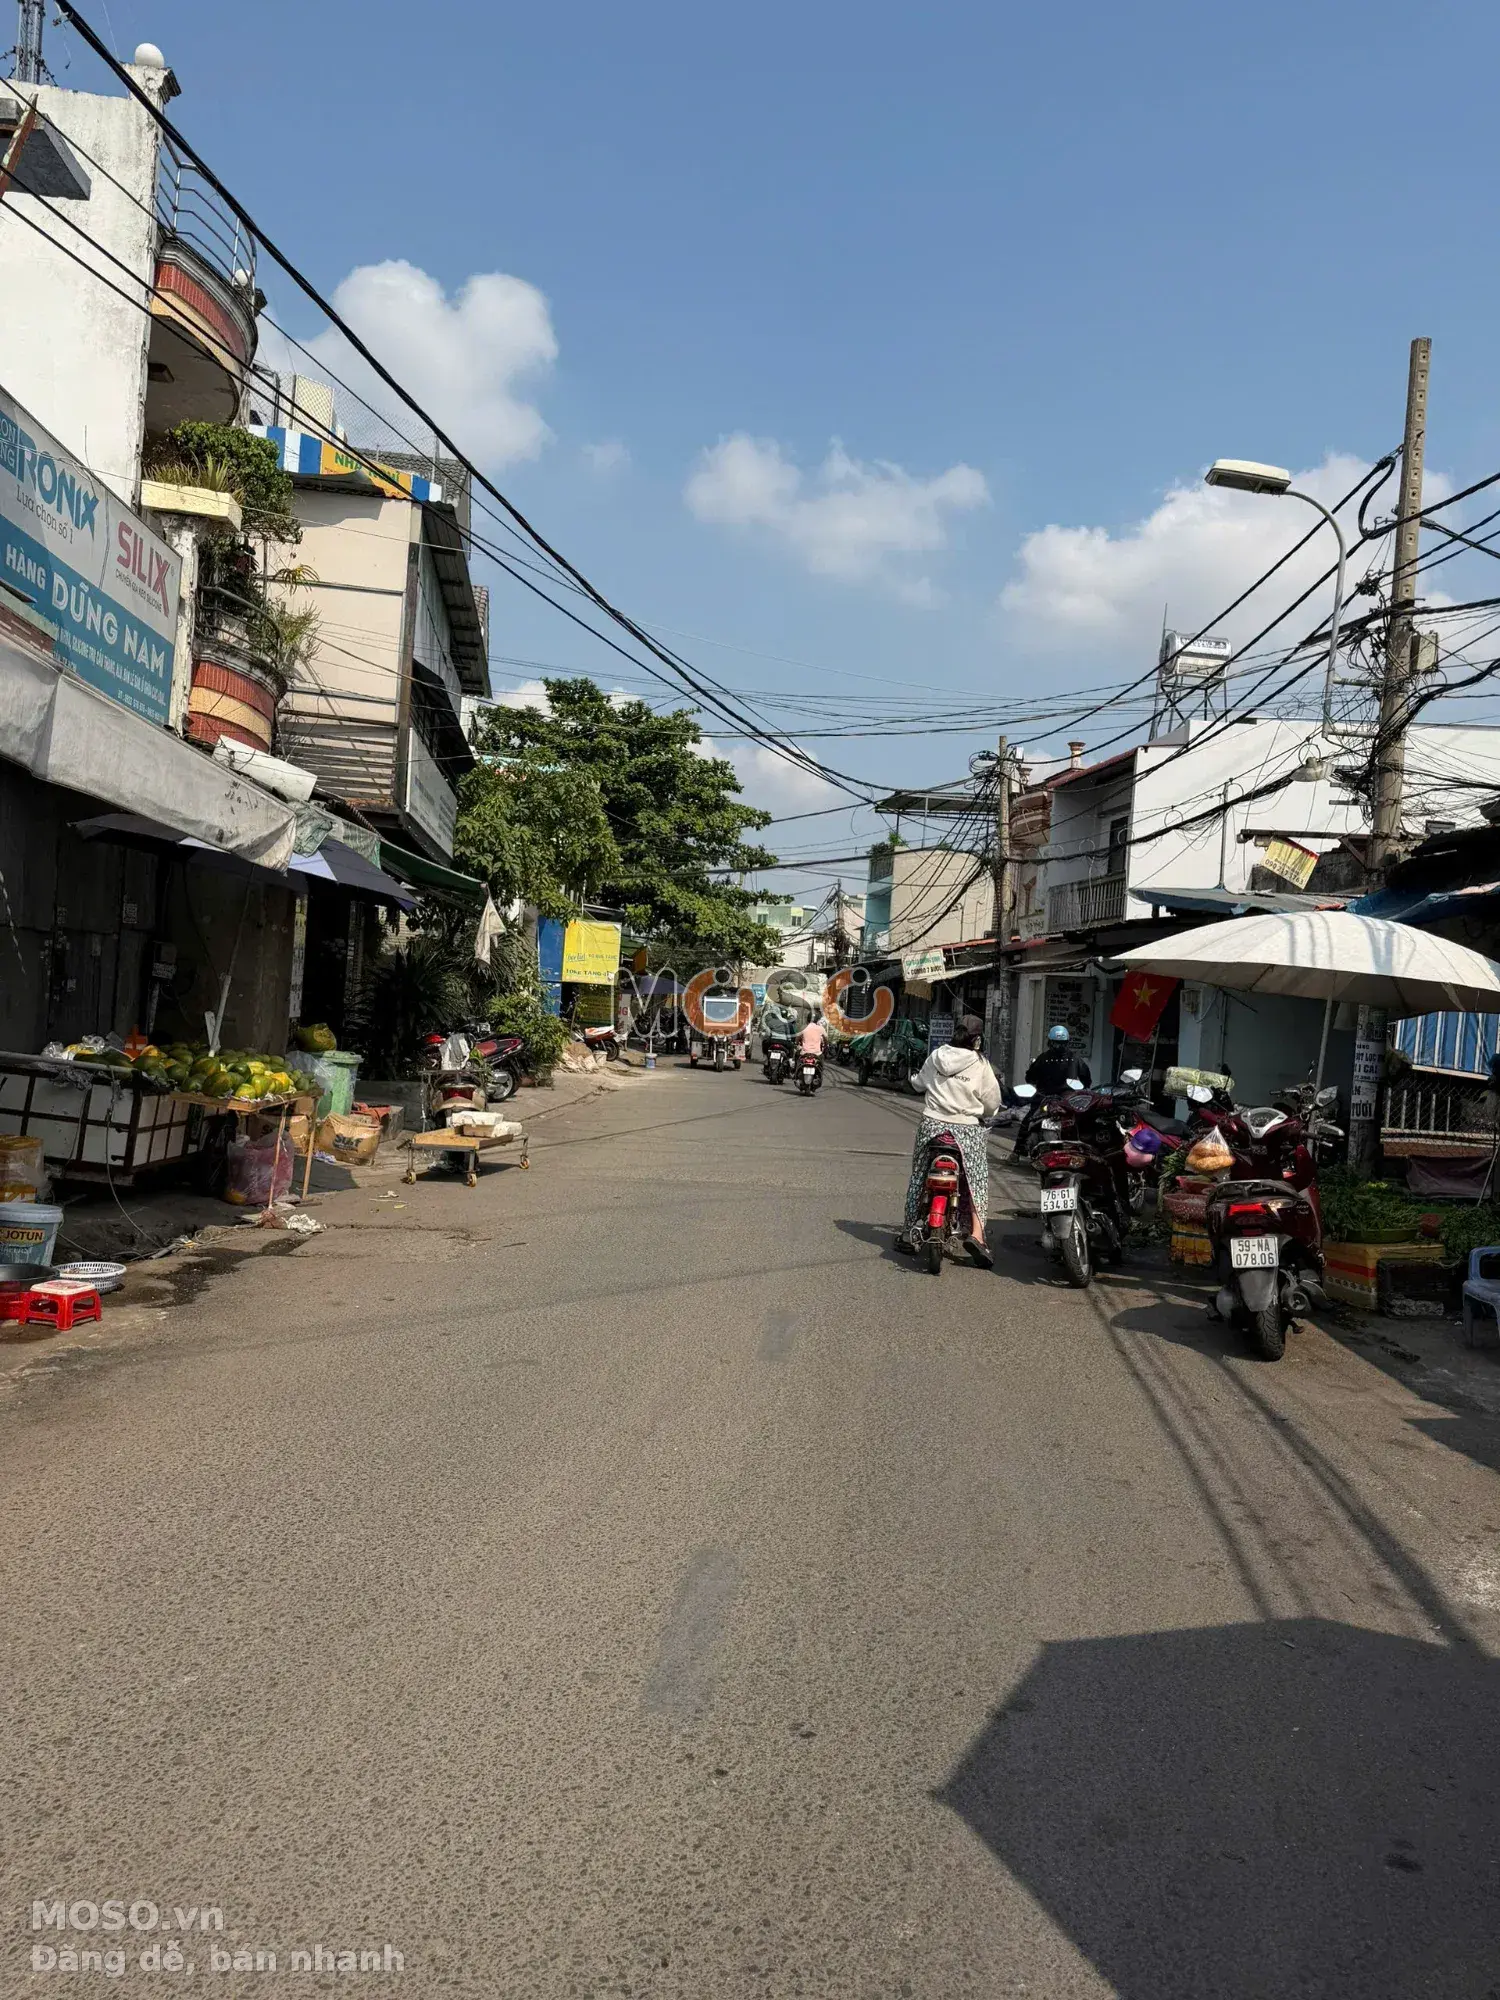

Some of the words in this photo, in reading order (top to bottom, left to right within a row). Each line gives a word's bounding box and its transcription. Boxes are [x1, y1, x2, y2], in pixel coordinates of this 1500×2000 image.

[18, 428, 100, 541] RONIX
[16, 485, 34, 510] Lựa
[36, 504, 57, 530] chọn
[116, 520, 170, 618] SILIX
[5, 543, 46, 591] HÀNG
[51, 572, 118, 645] DŨNG
[124, 624, 165, 679] NAM
[1043, 1199, 1075, 1211] 534.83
[5, 1230, 43, 1241] JOTUN
[1235, 1252, 1275, 1266] 078.06
